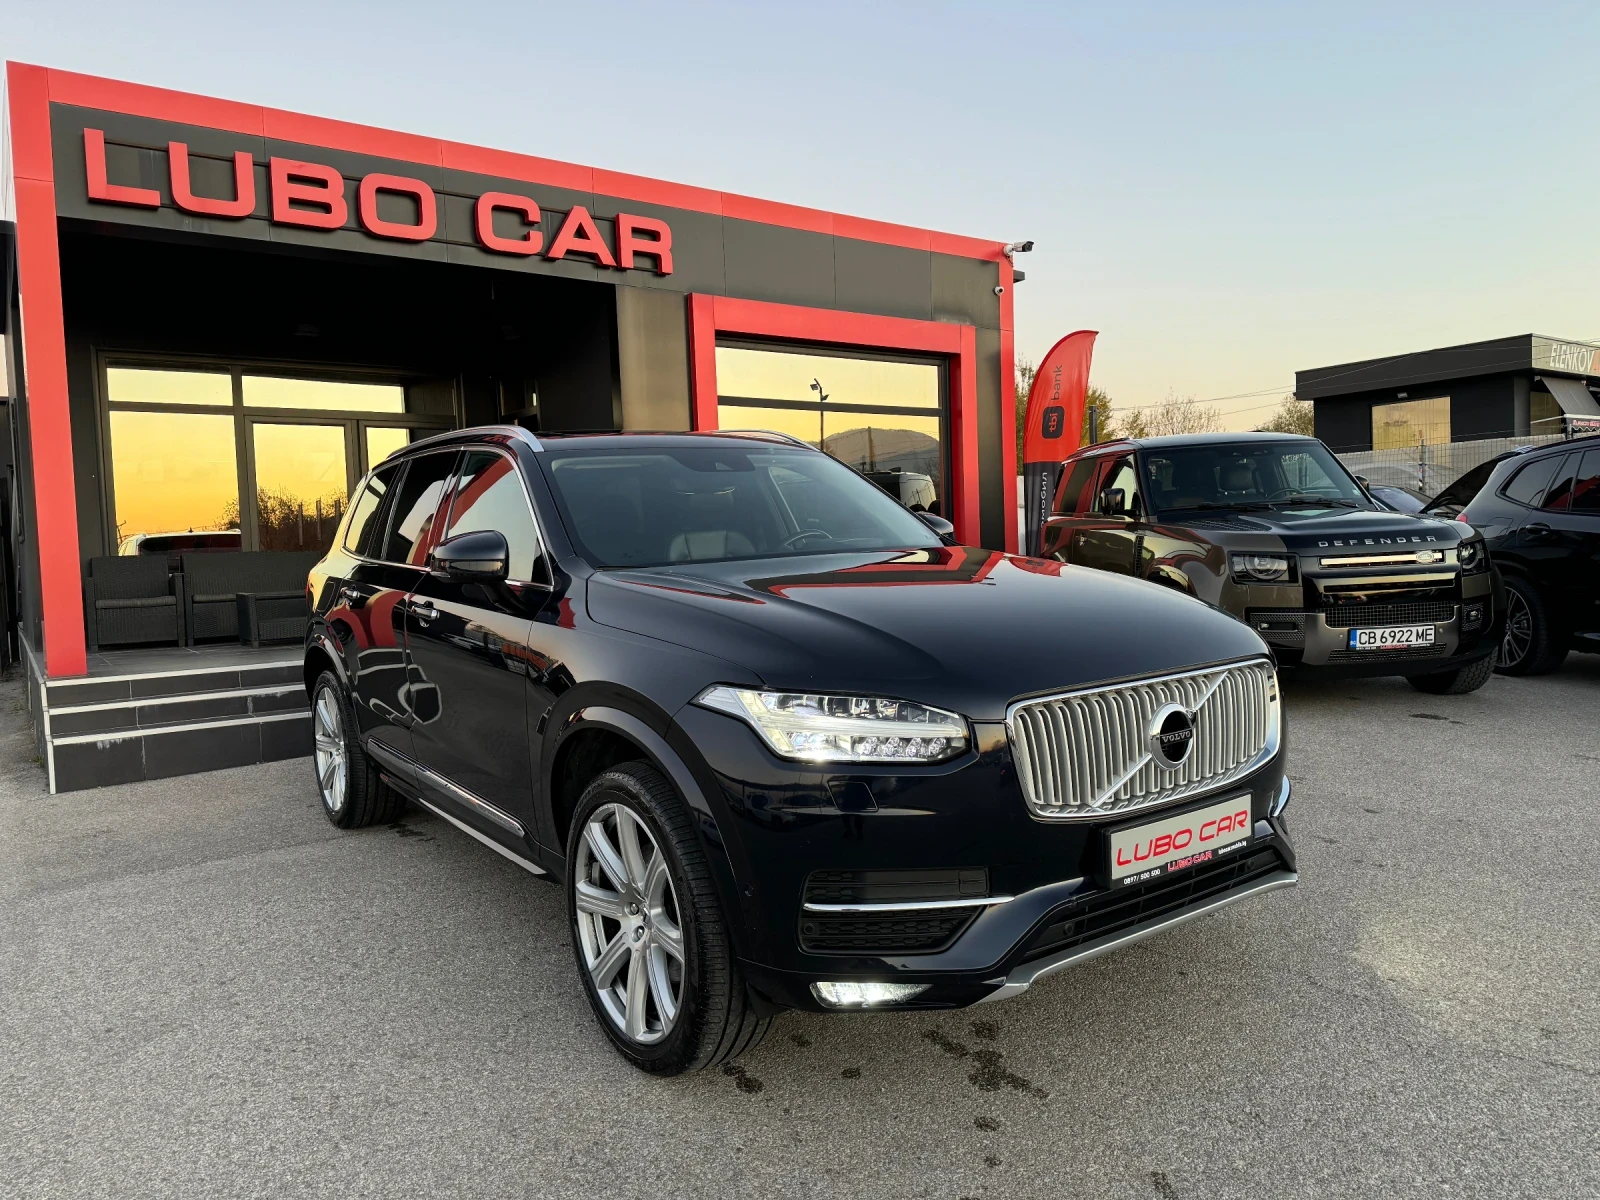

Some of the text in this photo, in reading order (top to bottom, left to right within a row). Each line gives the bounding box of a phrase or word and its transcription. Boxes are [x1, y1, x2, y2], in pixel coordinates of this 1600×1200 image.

[83, 128, 674, 276] LUBO CAR
[1549, 343, 1595, 372] ELENKOV
[1049, 364, 1062, 432] tbi bank
[1318, 536, 1437, 547] DEFENDER
[1359, 631, 1377, 645] CB
[1380, 629, 1413, 643] 6922
[1416, 627, 1434, 642] ME
[1161, 730, 1191, 743] VOLVO
[1116, 809, 1248, 867] LUBO CAR
[1140, 871, 1151, 880] 500
[1150, 868, 1161, 877] 500
